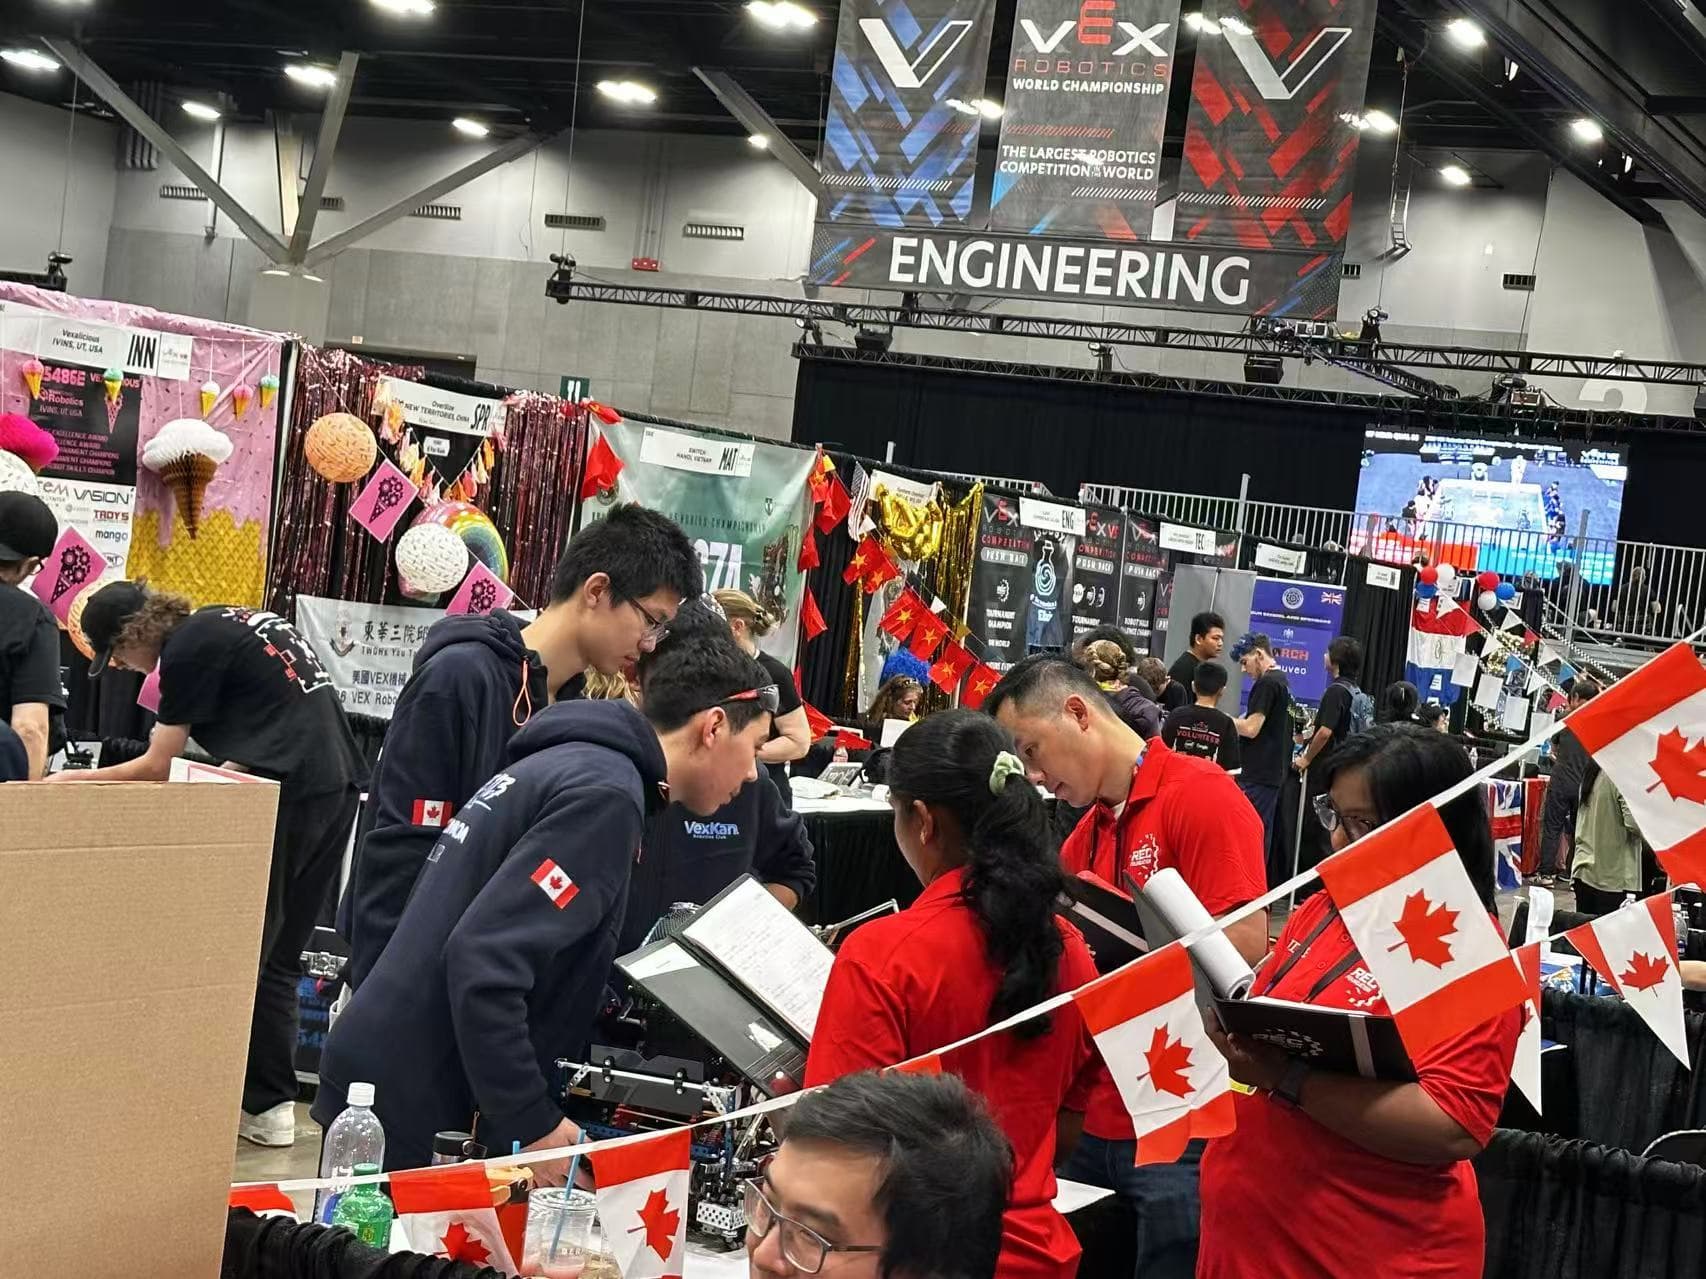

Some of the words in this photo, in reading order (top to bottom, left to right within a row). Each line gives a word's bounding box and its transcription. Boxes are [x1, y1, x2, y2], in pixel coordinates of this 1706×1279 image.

[1019, 0, 1171, 57] VEX
[1014, 58, 1168, 78] ROBOTICS
[1012, 78, 1060, 92] WORLD
[1062, 79, 1165, 96] CHAMPIONSHIP
[1002, 145, 1027, 159] THE
[1029, 146, 1086, 162] LARGEST
[1087, 150, 1156, 165] ROBOTICS
[1000, 161, 1090, 178] COMPETITION
[1103, 166, 1154, 181] WORLD
[889, 237, 1250, 306] ENGINEERING
[62, 329, 100, 343] Vexalicious
[89, 344, 103, 354] USA
[127, 334, 157, 369] INN
[470, 404, 491, 431] SPR
[718, 448, 739, 471] MAT
[1061, 510, 1074, 530] ENG
[95, 530, 129, 543] mango
[351, 691, 371, 705] VEX
